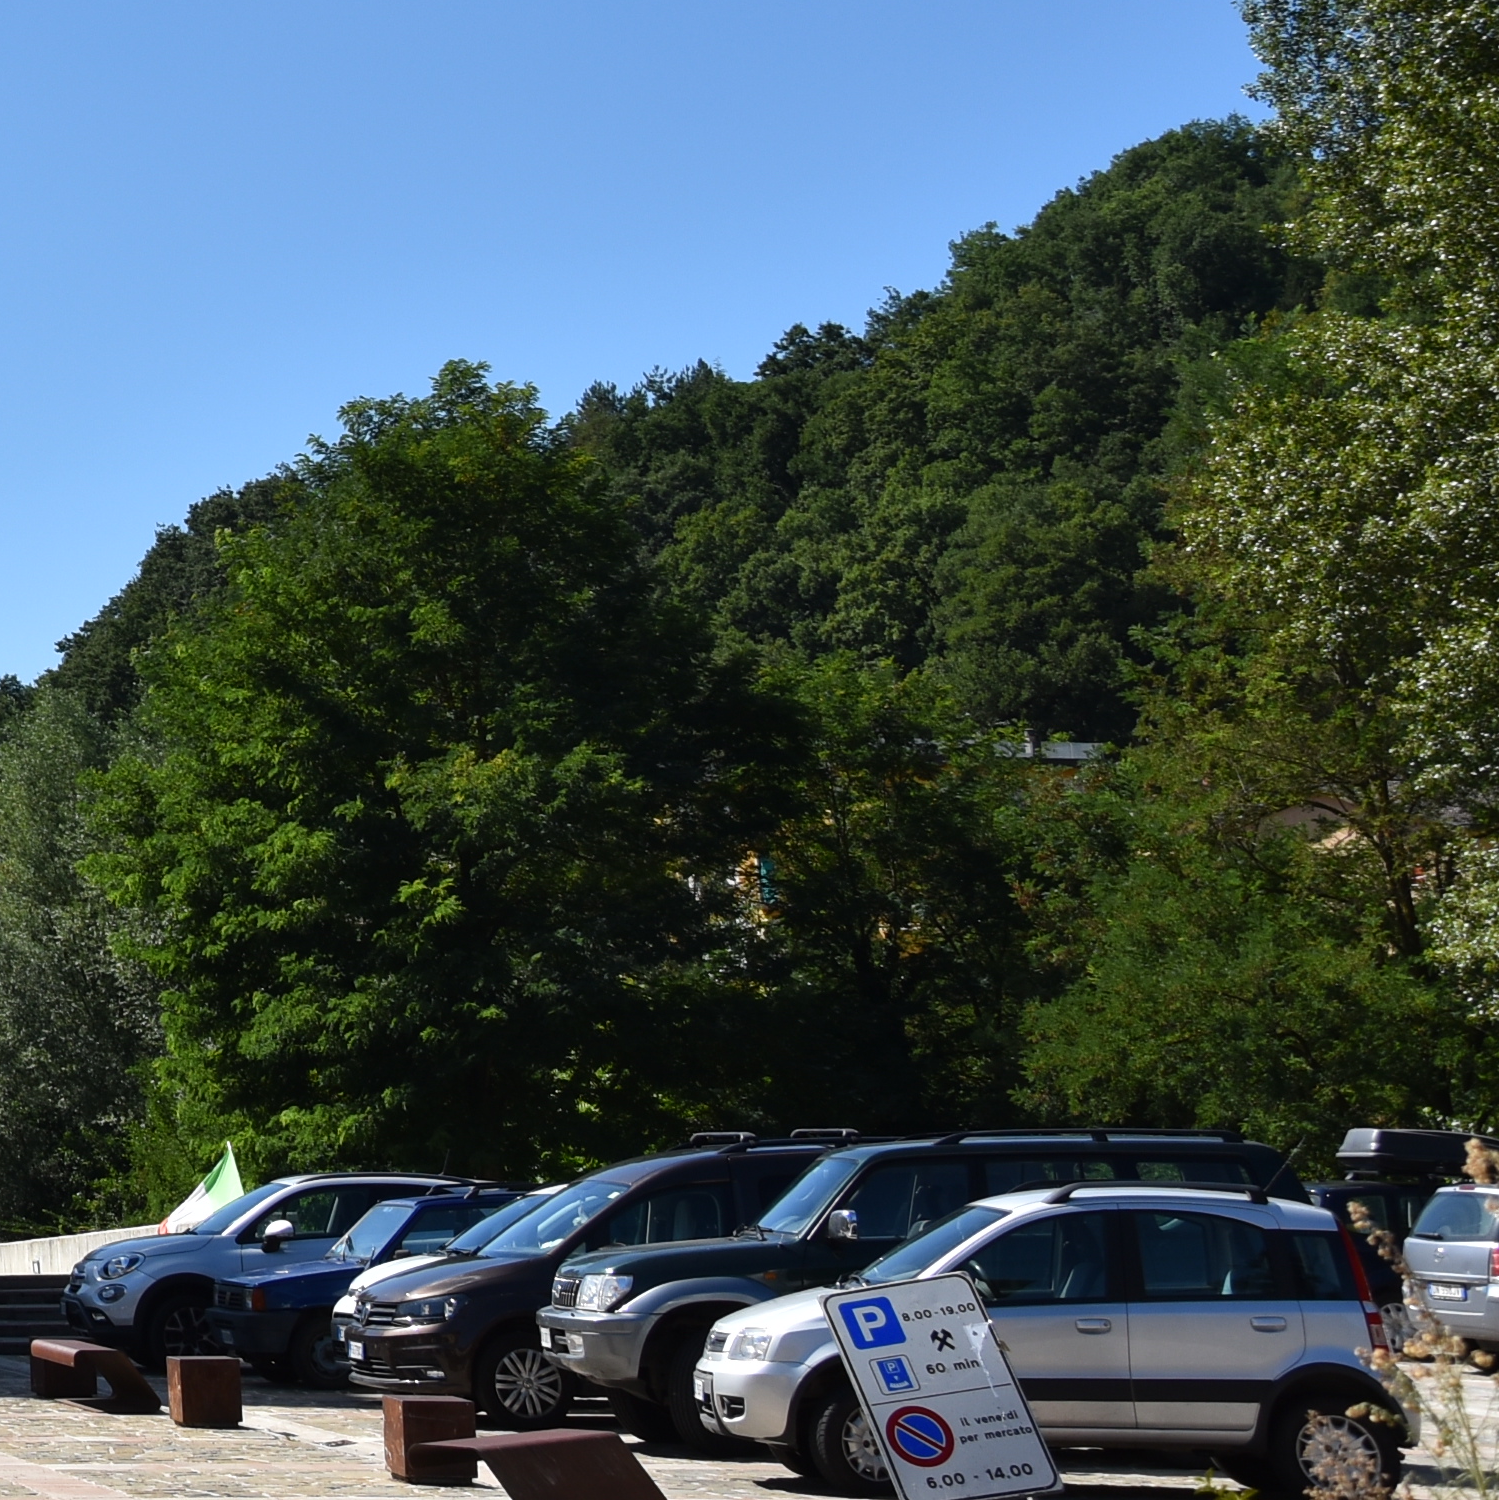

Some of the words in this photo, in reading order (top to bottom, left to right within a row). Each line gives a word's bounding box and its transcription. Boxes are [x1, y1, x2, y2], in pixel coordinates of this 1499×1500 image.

[853, 1305, 887, 1342] P
[926, 1363, 946, 1375] 60
[953, 1358, 981, 1371] min
[960, 1417, 970, 1426] il
[960, 1434, 978, 1444] per
[984, 1426, 1033, 1440] mercato
[926, 1473, 965, 1489] 6.00
[986, 1463, 1033, 1480] 14.00
